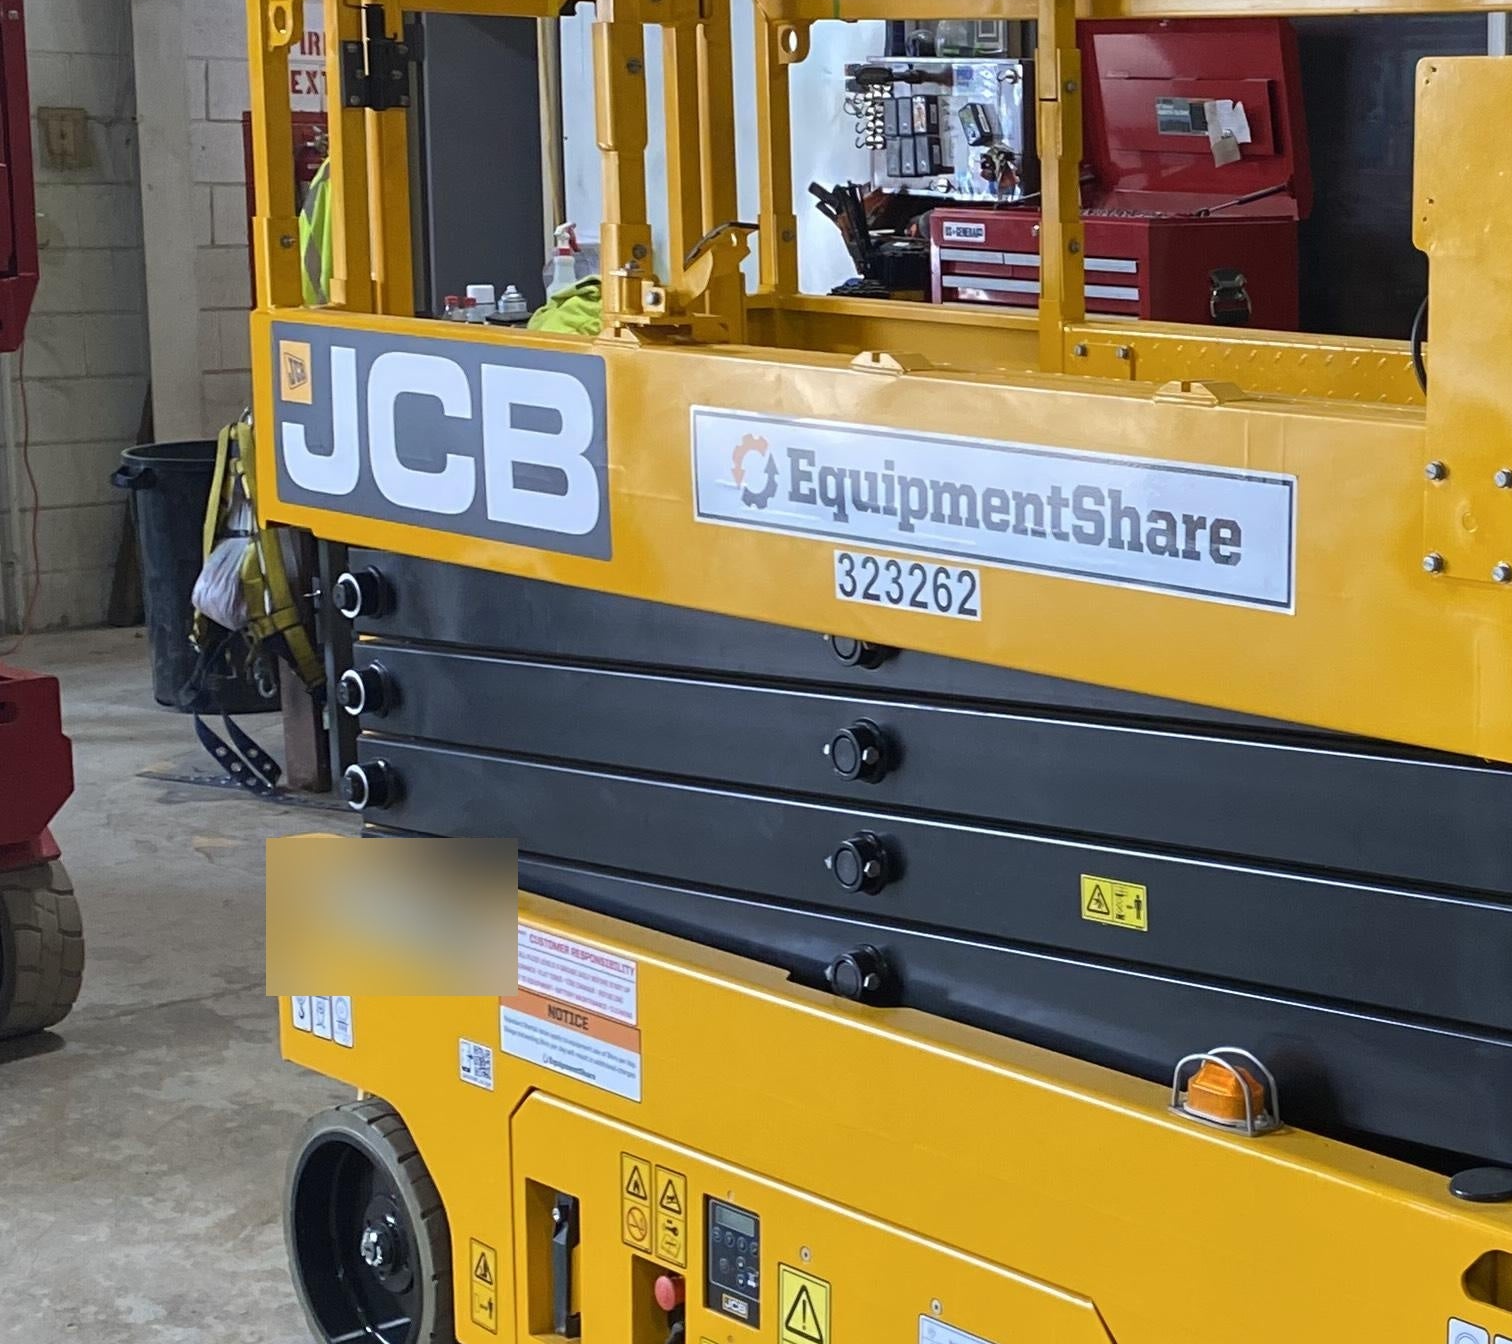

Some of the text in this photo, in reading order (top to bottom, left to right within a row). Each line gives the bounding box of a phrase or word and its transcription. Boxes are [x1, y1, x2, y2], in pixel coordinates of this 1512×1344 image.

[281, 345, 600, 536] JCB
[787, 447, 1242, 566] EquipmentShare
[837, 552, 979, 617] 323262
[529, 932, 570, 956] CUSTOMER
[571, 947, 635, 977] RESPONSIBILITY
[547, 1004, 589, 1031] NOTICE
